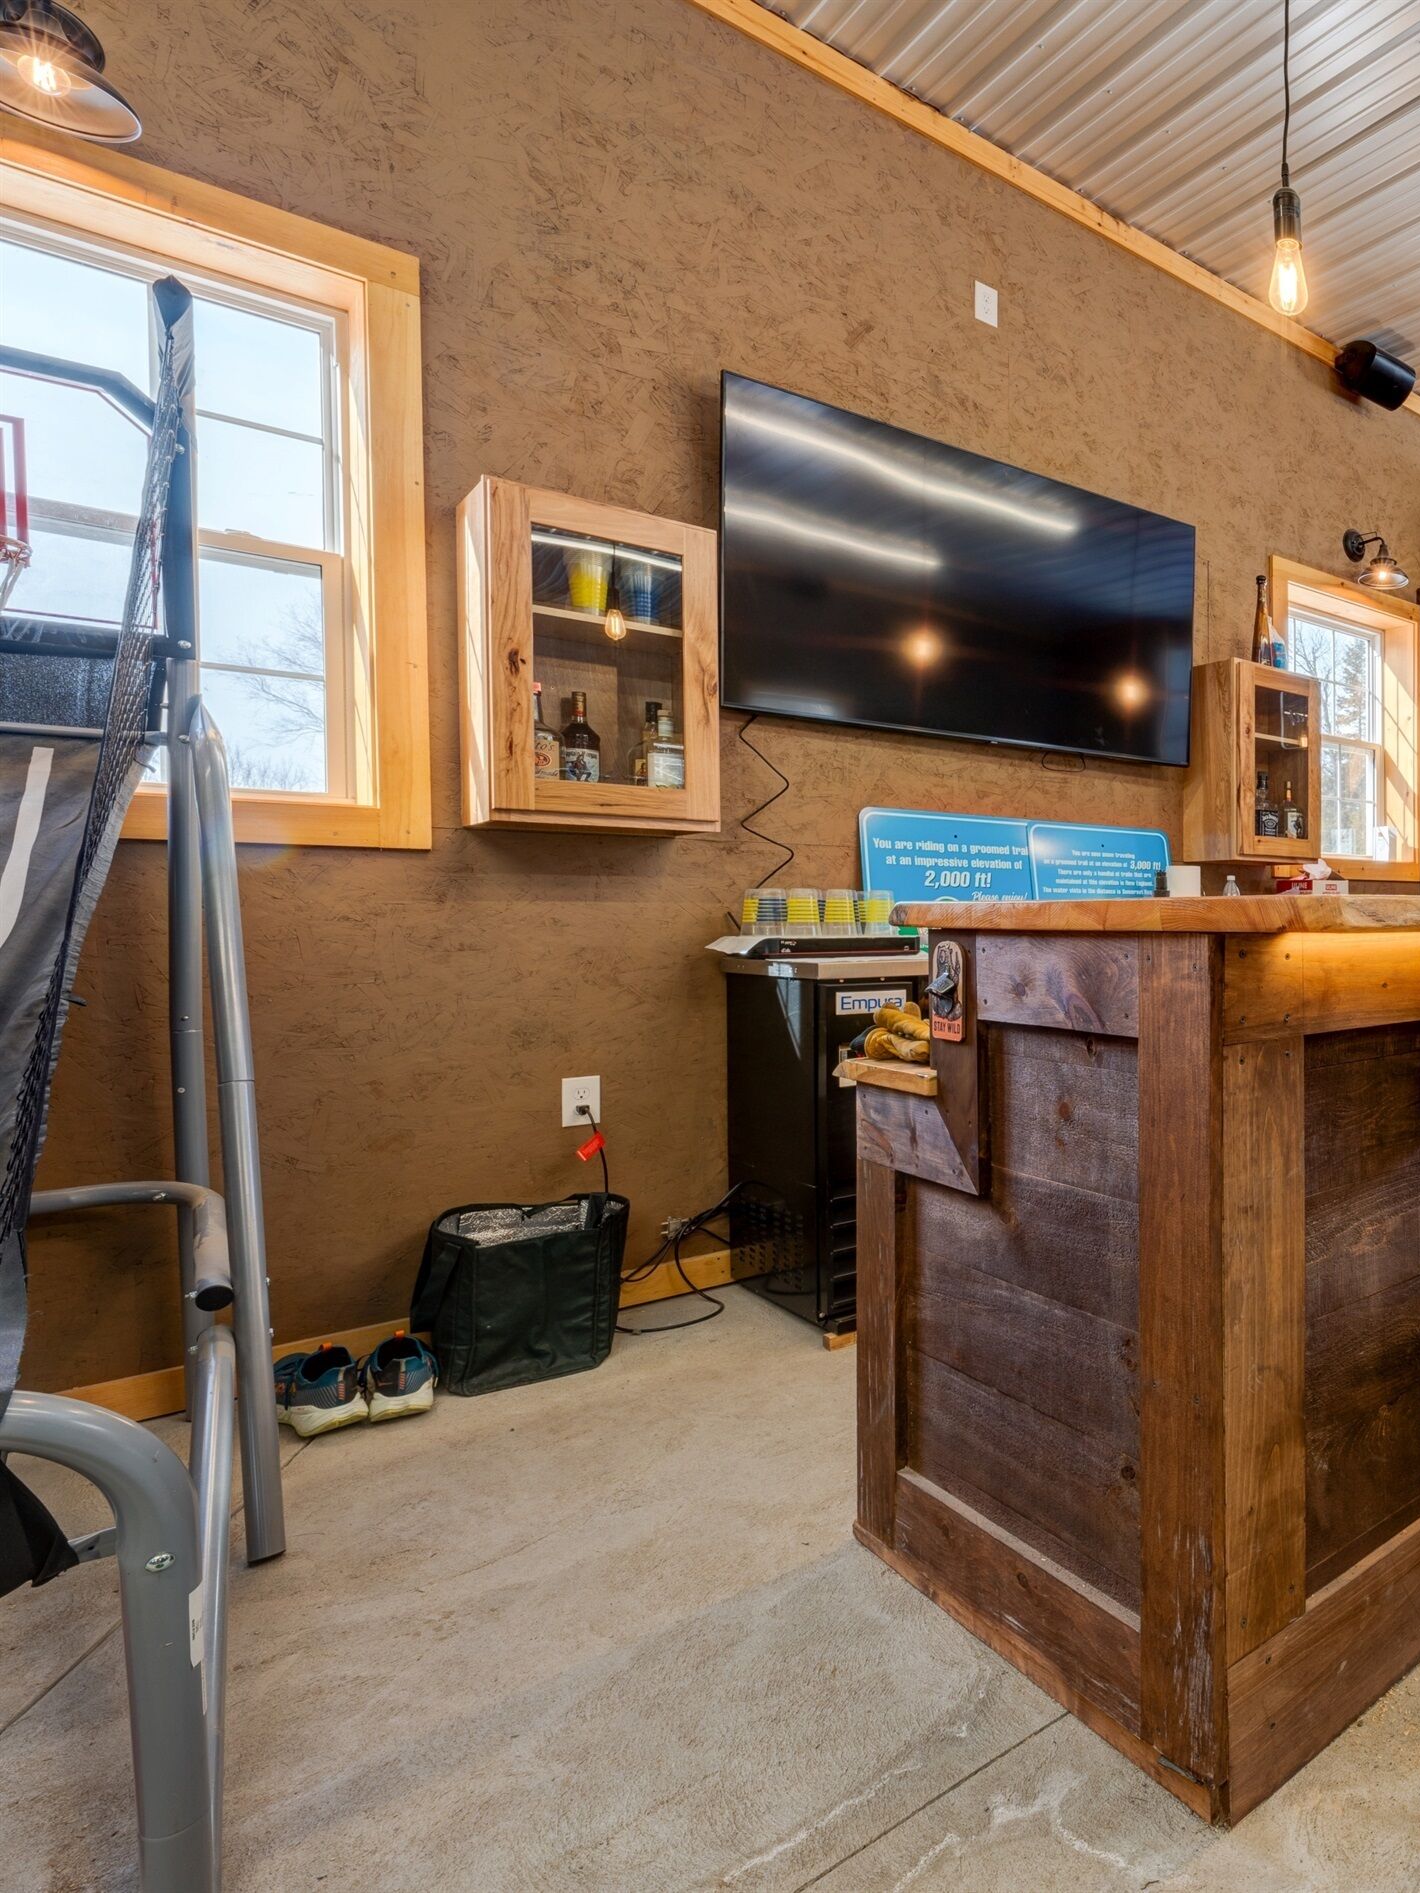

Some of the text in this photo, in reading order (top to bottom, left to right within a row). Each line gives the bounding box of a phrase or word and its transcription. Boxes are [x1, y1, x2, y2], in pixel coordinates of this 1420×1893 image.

[873, 837, 1029, 855] You are riding on a groomed trai
[885, 855, 1023, 870] at an impressive elevation of
[1130, 860, 1152, 870] 3,000
[924, 870, 992, 889] 2,000 ft!
[971, 890, 1000, 901] Please
[934, 1020, 961, 1034] STAY WILD
